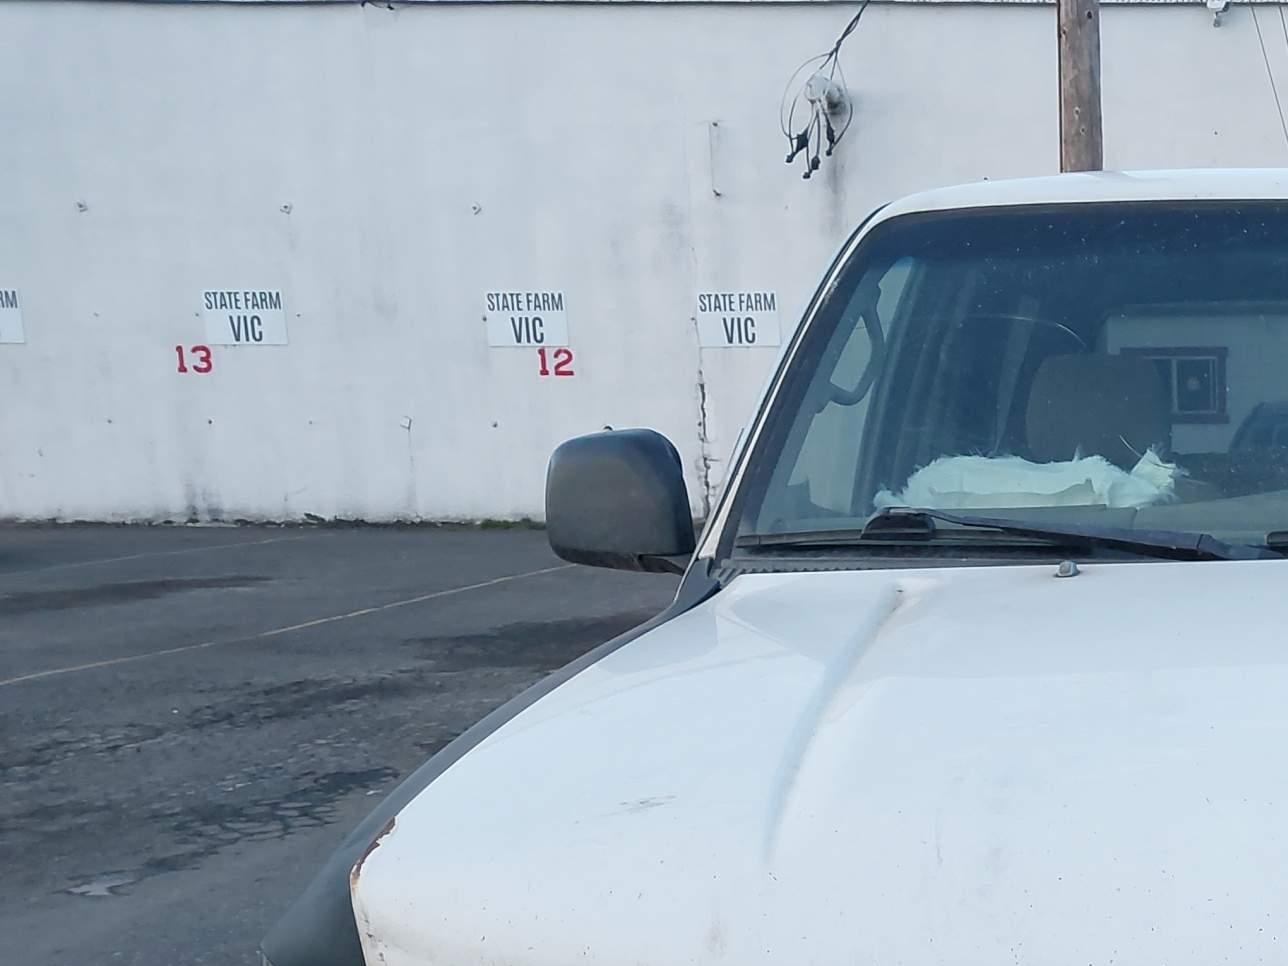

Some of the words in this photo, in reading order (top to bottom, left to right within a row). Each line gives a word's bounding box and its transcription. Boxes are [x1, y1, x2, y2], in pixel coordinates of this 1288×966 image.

[204, 291, 242, 310] STATE
[244, 291, 282, 310] FARM
[487, 292, 524, 312] STATE
[526, 292, 564, 312] FARM
[699, 293, 736, 312] STATE
[739, 293, 776, 312] FARM
[229, 315, 264, 343] VIC
[510, 316, 545, 344] VIC
[722, 317, 756, 344] VIC
[175, 345, 214, 374] 13
[537, 348, 575, 376] 12
